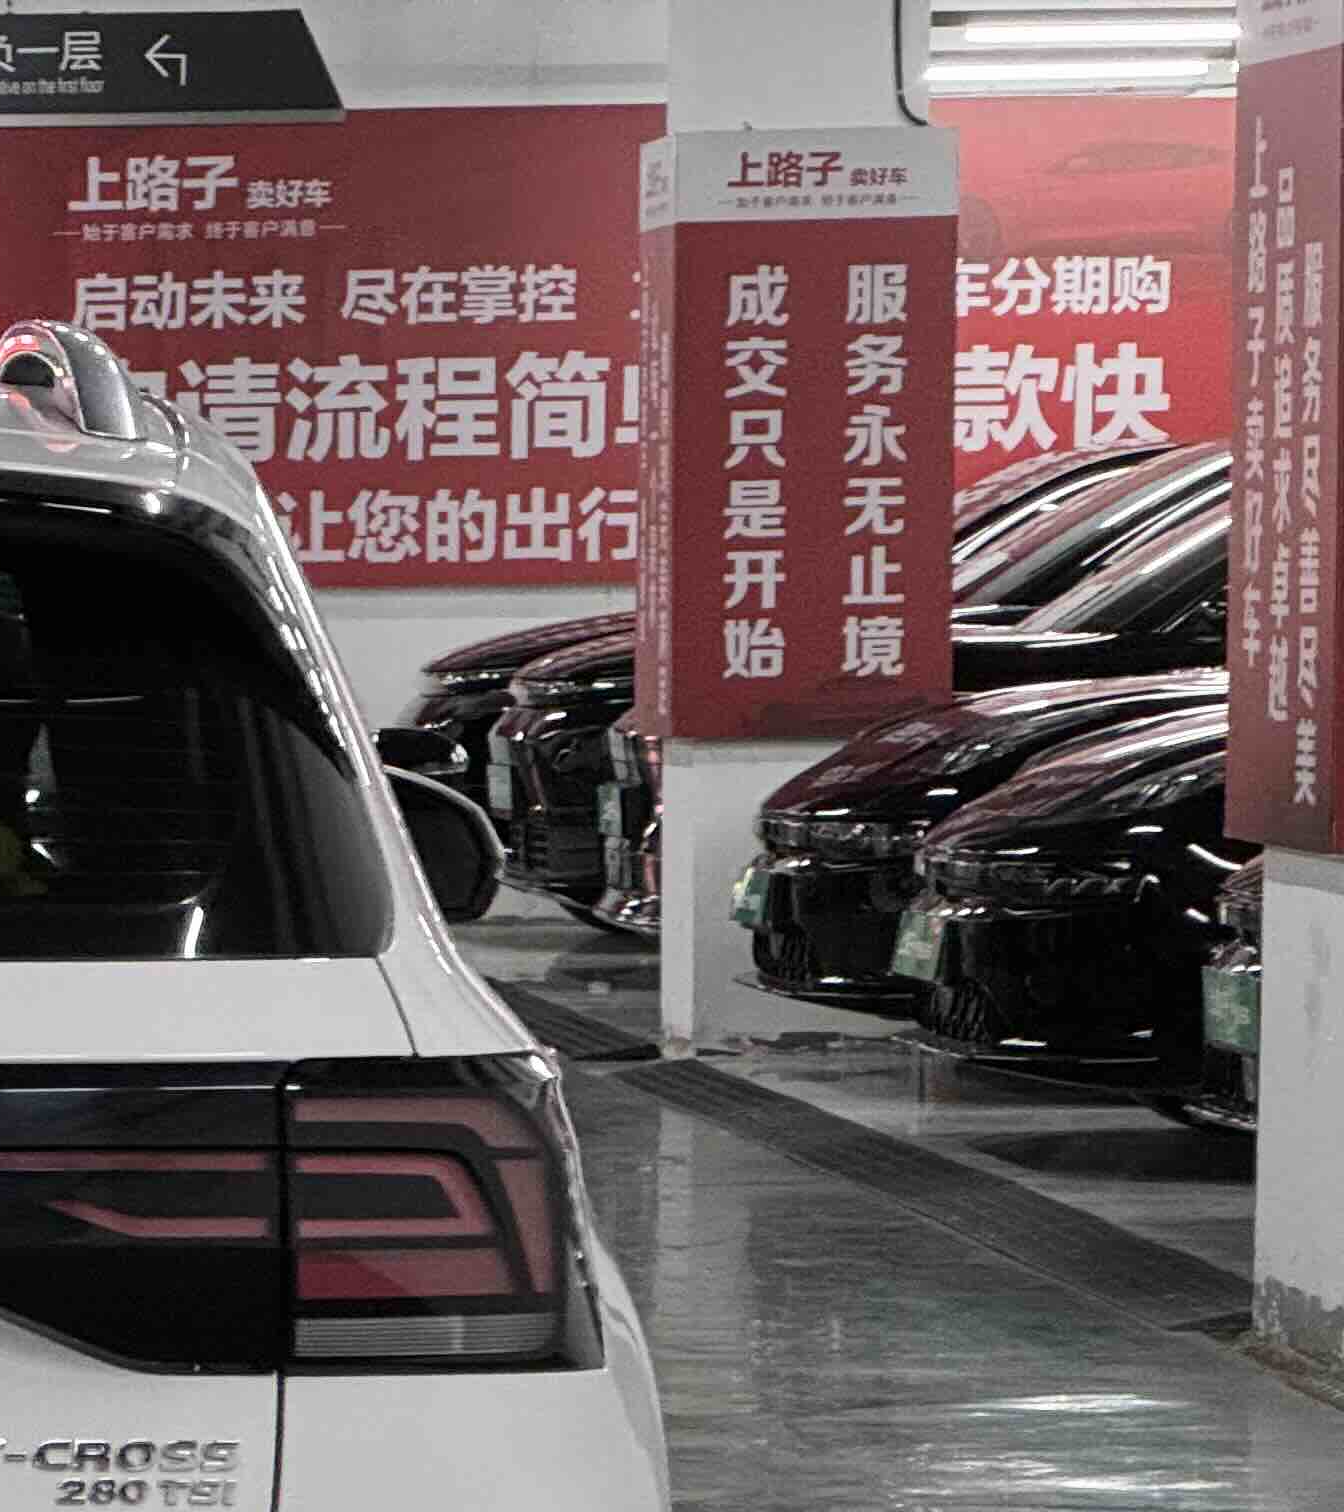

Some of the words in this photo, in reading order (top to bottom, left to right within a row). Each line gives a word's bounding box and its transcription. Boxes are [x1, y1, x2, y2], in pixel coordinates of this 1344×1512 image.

[67, 155, 240, 211] 上路子
[246, 179, 334, 209] 卖好车
[728, 151, 843, 188] 上路子
[72, 270, 308, 333] 启动未来
[339, 264, 579, 325] 尽在掌控
[953, 342, 1171, 453] 款快
[722, 264, 790, 680] 成交只是开始
[840, 263, 909, 680] 服务永无止境
[55, 1479, 148, 1506] 280
[157, 1479, 238, 1507] TSI
